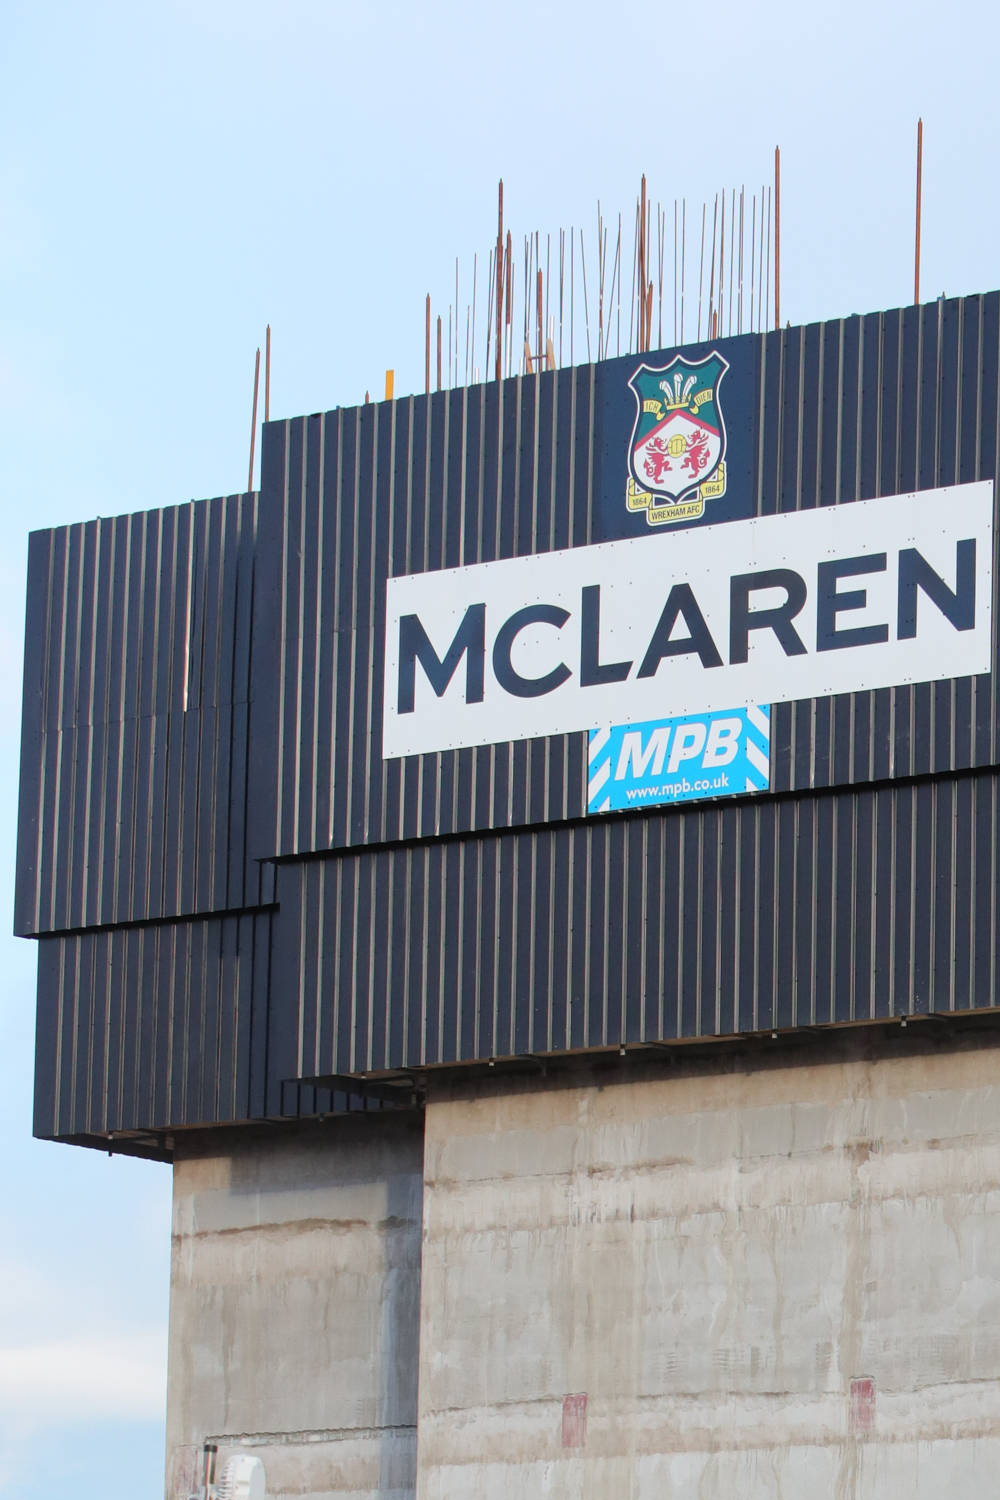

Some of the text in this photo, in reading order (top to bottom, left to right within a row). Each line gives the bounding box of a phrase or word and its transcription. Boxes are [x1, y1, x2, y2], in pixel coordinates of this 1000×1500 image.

[705, 485, 720, 494] 1864
[632, 497, 647, 506] 1864
[651, 504, 700, 520] WREXHAM AFC
[397, 538, 976, 715] MCLAREN
[614, 717, 743, 781] MPB
[626, 772, 729, 800] www.mpb.co.uk
